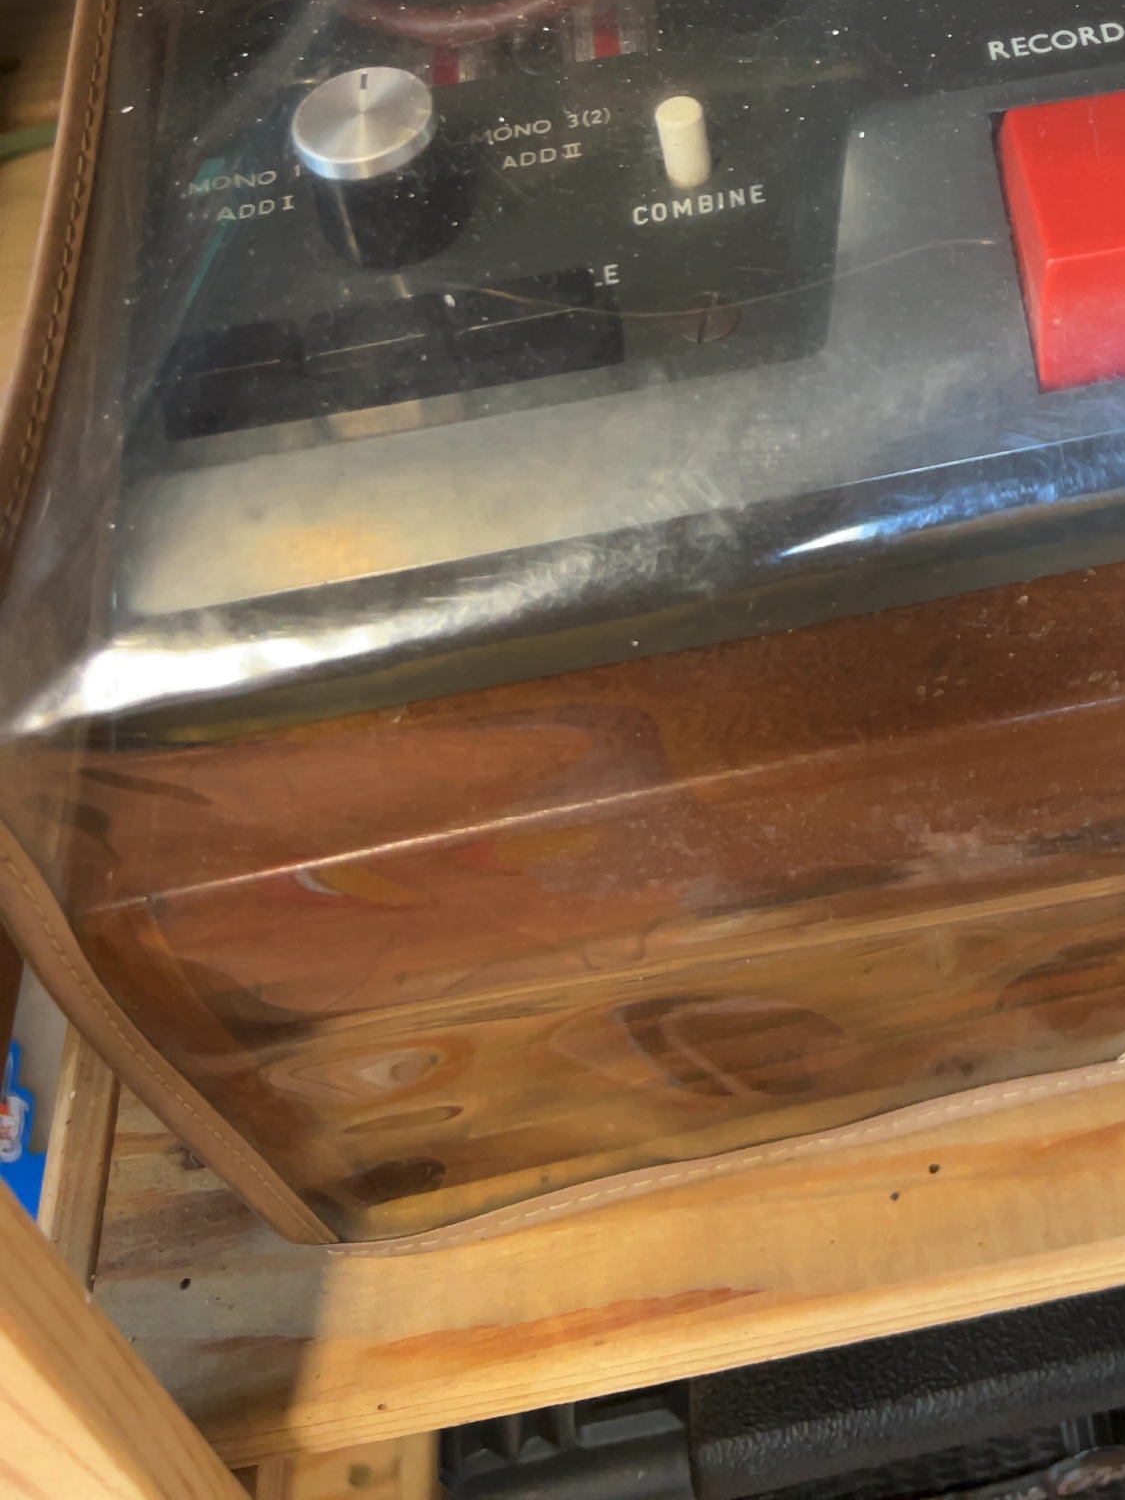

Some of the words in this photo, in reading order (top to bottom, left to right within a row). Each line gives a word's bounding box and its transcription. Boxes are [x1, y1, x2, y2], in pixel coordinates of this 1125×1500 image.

[988, 22, 1125, 61] RECORD
[470, 119, 552, 145] MONO
[567, 107, 611, 129] 3(2)
[188, 170, 277, 195] MONO
[632, 184, 766, 226] COMBINE
